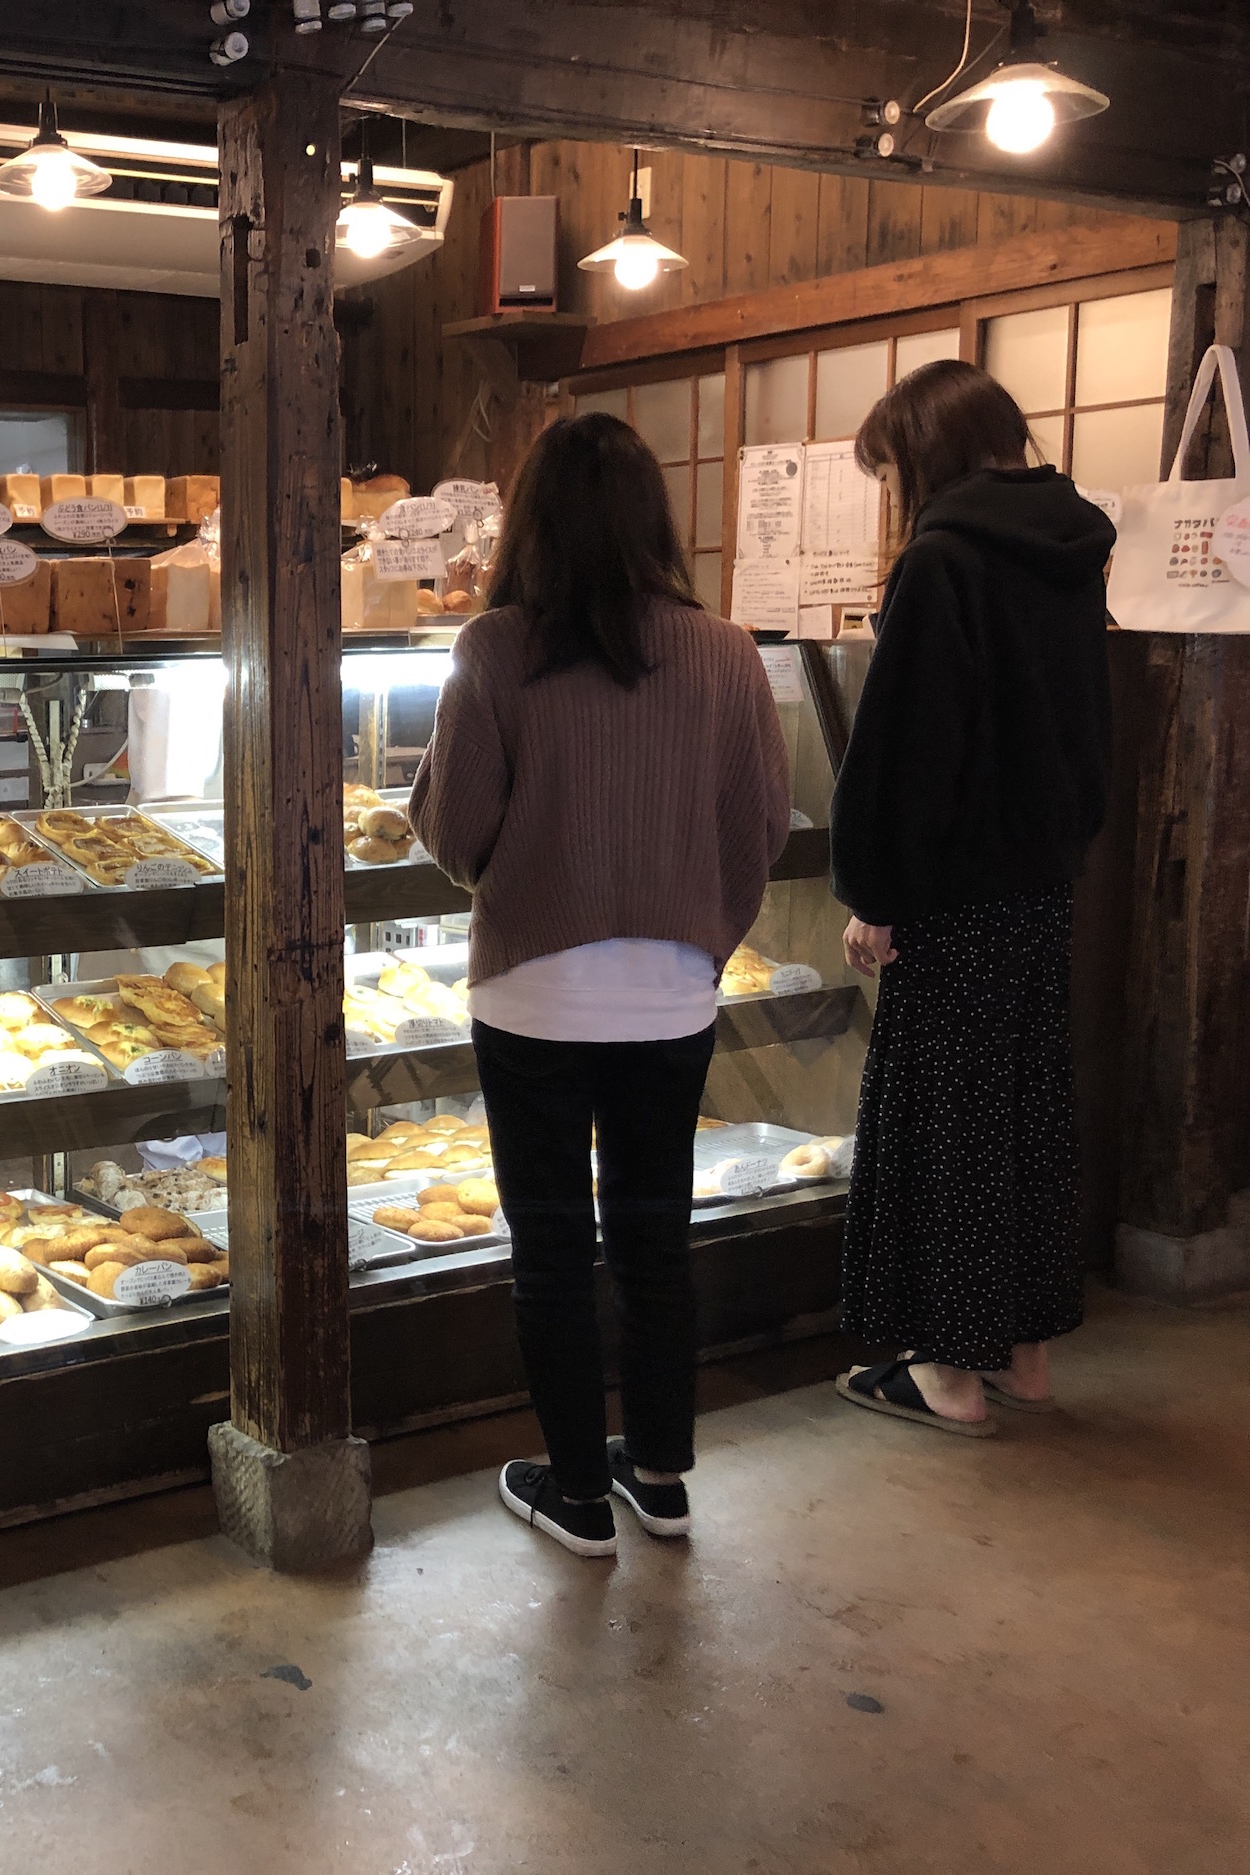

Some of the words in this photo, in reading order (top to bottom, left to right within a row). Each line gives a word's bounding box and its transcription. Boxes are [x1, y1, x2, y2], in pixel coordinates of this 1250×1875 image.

[15, 866, 63, 878] スイートポテト
[143, 1052, 181, 1063] コーンパン
[49, 1064, 81, 1076] オニオン
[135, 1262, 172, 1276] カレーパン
